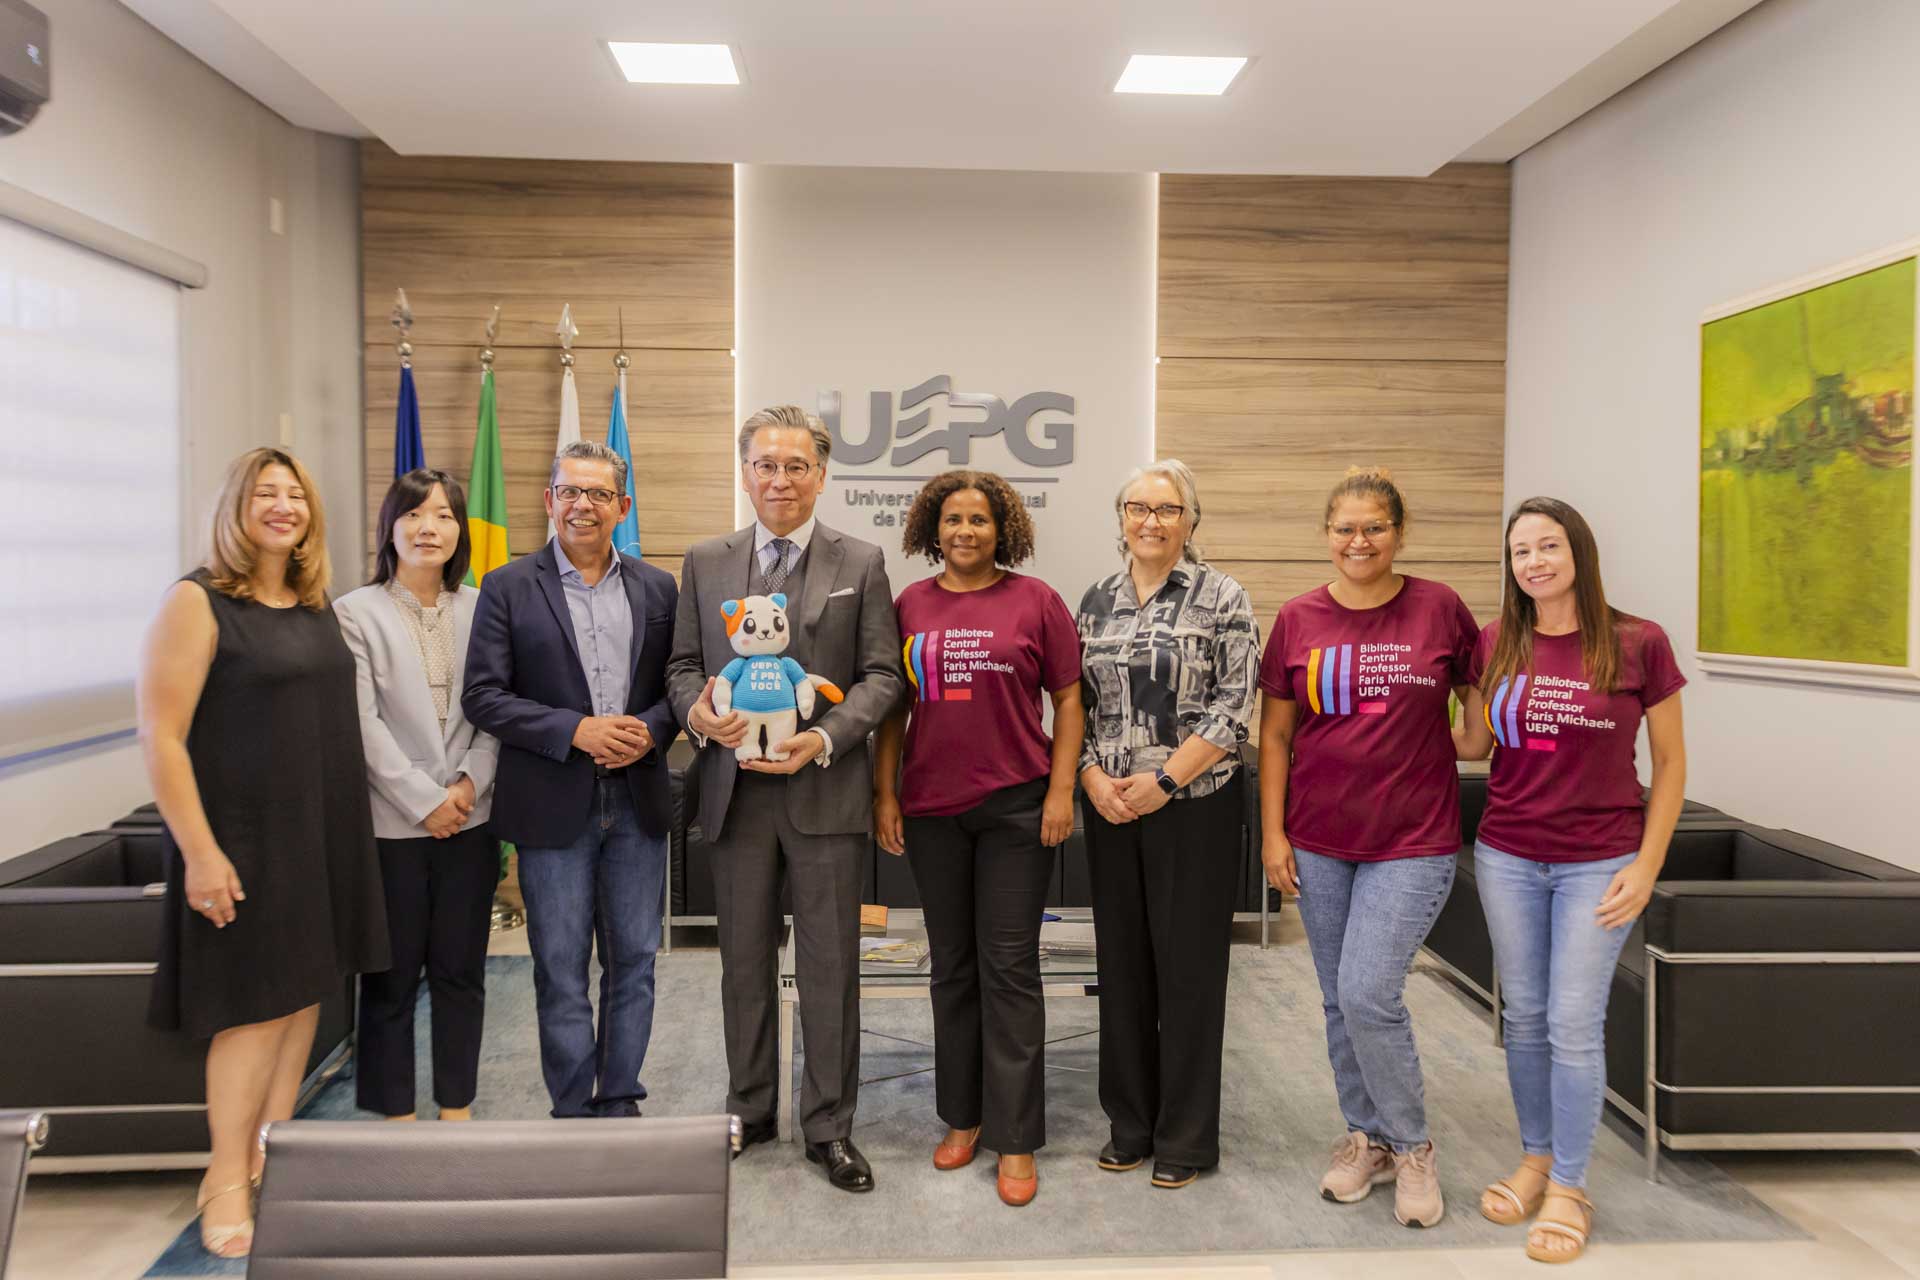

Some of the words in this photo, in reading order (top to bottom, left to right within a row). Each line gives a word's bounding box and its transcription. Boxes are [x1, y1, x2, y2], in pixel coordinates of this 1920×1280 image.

[817, 375, 1075, 468] UEPG
[845, 489, 919, 506] Univers
[873, 510, 895, 527] de
[945, 628, 994, 638] Biblioteca
[944, 638, 980, 649] Central
[1360, 642, 1411, 653] Biblioteca
[943, 649, 991, 660] Professor
[1359, 652, 1398, 663] Central
[943, 661, 967, 671] Faris
[969, 660, 1014, 674] Michaele
[1359, 663, 1411, 673] Professor
[944, 672, 973, 683] UEPG
[1358, 674, 1385, 685] Faris
[1388, 673, 1436, 687] Michaele
[1534, 675, 1590, 691] Biblioteca
[1359, 686, 1390, 696] UEPG
[1531, 687, 1573, 700] Central
[1527, 699, 1585, 713] Professor
[1525, 710, 1554, 722] Faris
[1557, 713, 1616, 729] Michaele
[1525, 722, 1559, 734] UEPG
